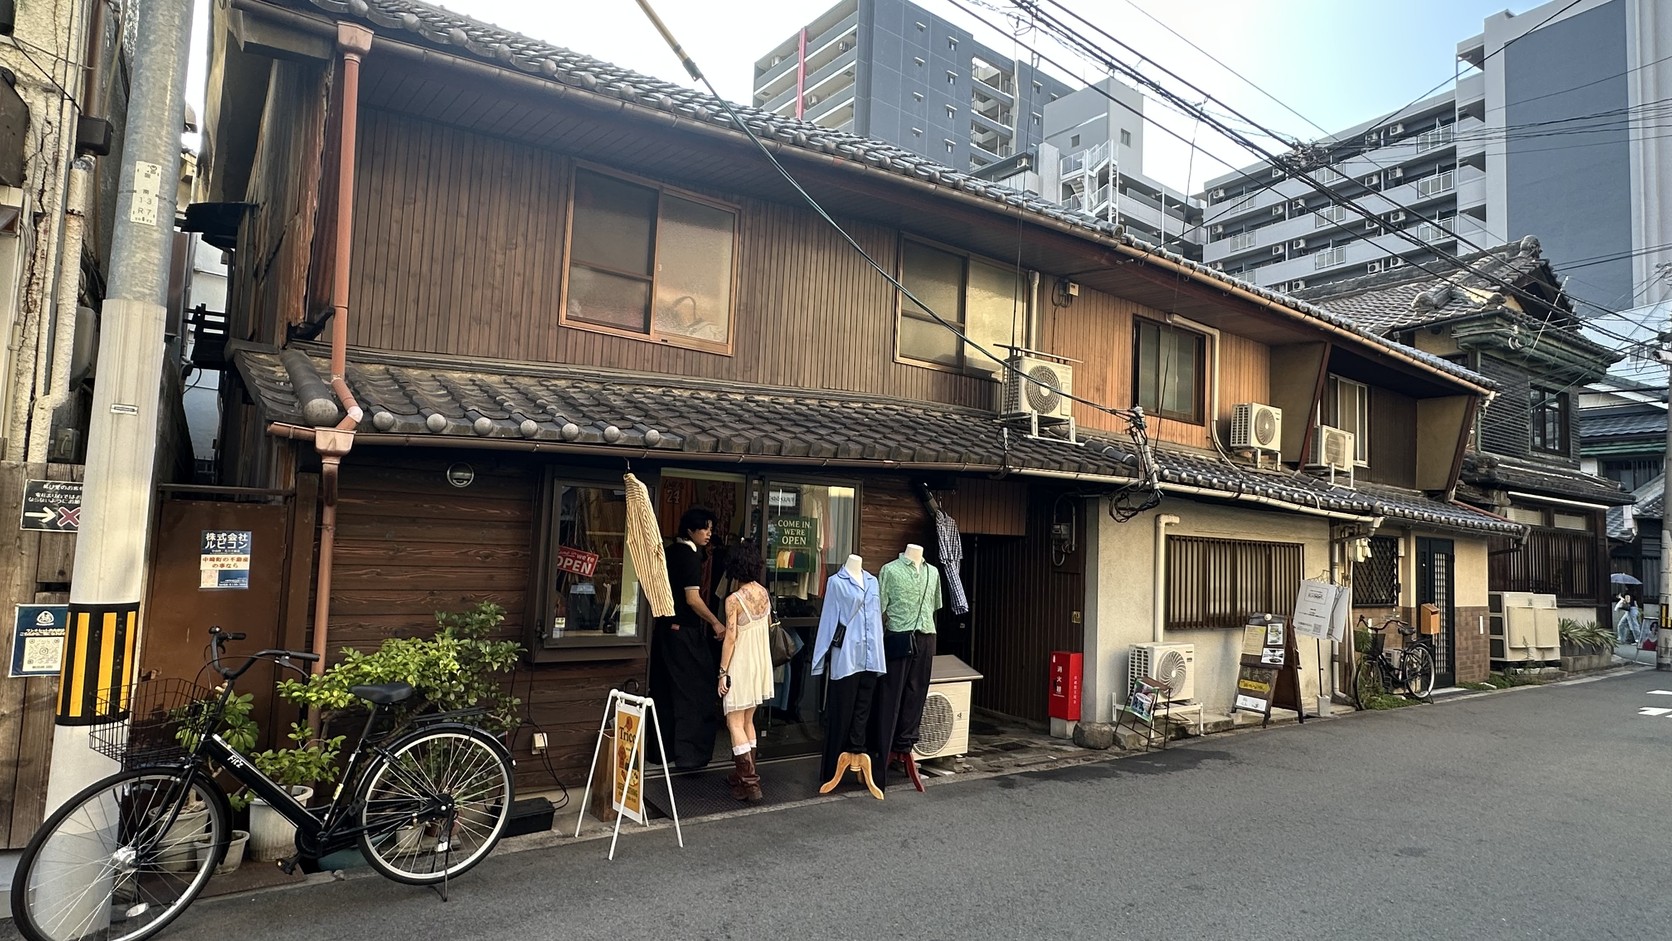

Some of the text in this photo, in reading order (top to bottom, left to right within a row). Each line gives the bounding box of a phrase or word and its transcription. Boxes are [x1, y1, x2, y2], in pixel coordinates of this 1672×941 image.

[777, 520, 800, 529] COME
[784, 528, 806, 536] WE'RE
[205, 532, 249, 542] 株式会社
[781, 536, 807, 545] OPEN
